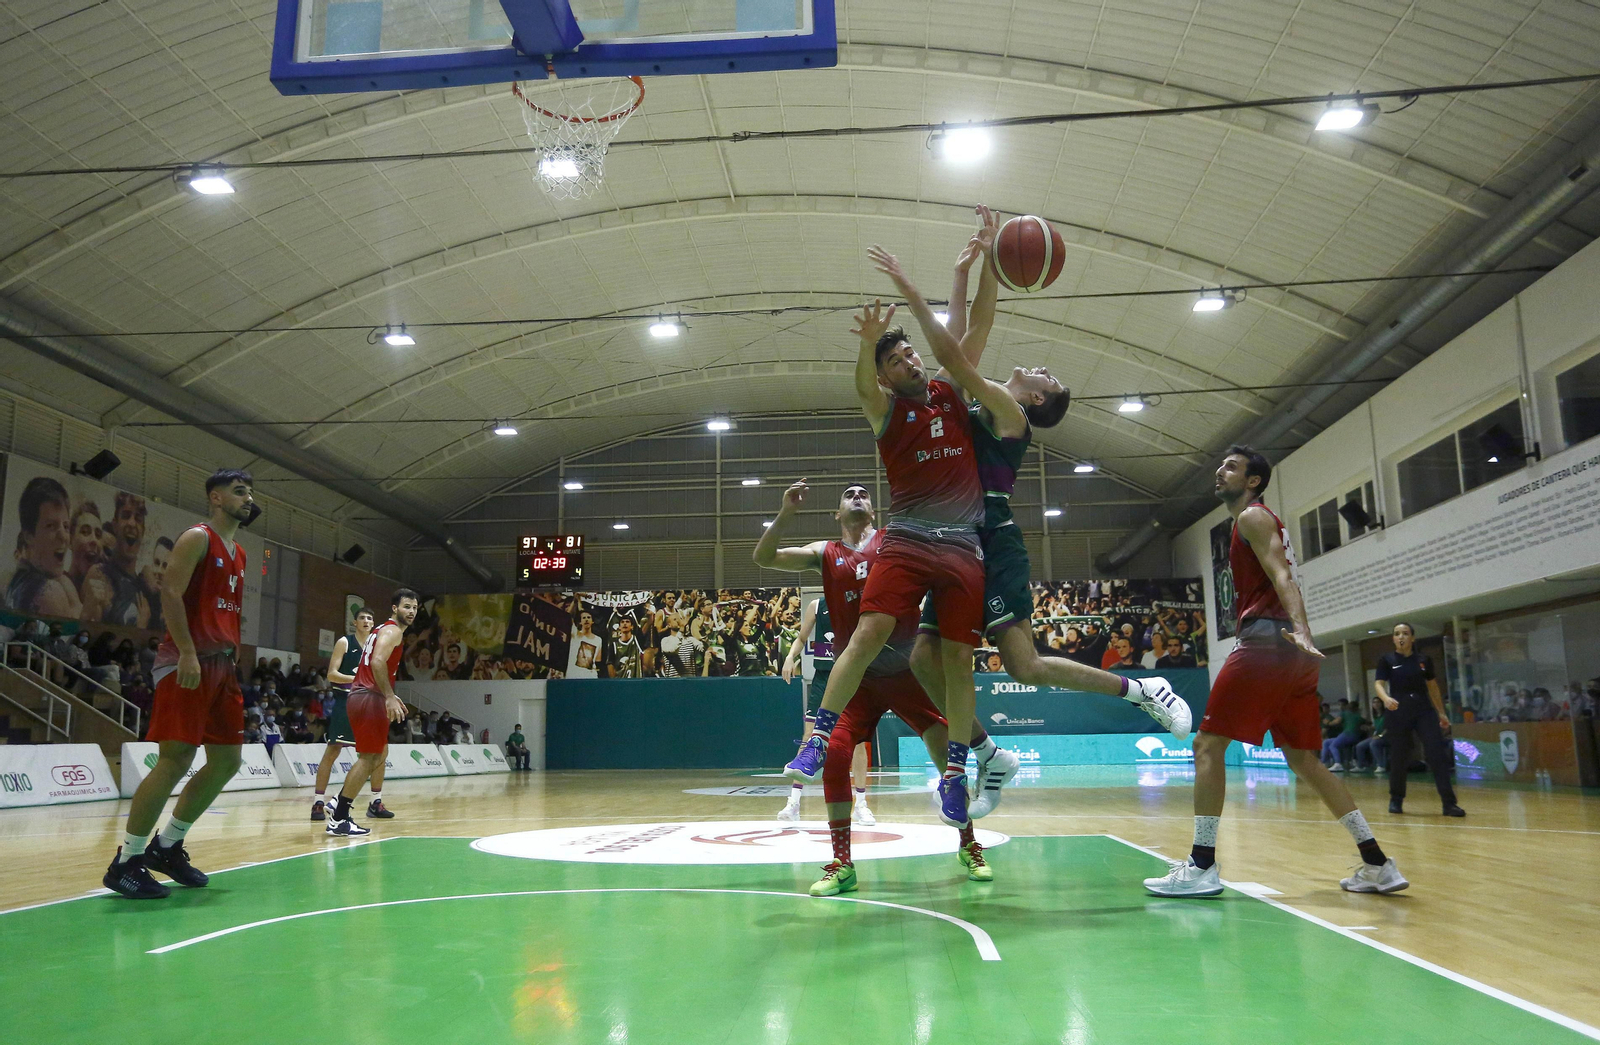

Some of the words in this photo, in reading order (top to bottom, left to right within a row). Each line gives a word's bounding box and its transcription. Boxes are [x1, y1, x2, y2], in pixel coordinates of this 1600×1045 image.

[930, 416, 944, 438] 2
[933, 450, 941, 459] El
[1498, 484, 1530, 505] JUGADORES
[1532, 480, 1540, 491] DE
[1541, 468, 1571, 487] CANTERA
[1572, 461, 1587, 475] QUE
[1588, 455, 1600, 468] HA
[523, 537, 537, 548] 97
[547, 542, 553, 550] 4
[566, 536, 581, 547] 81
[533, 557, 566, 569] 02:39
[523, 568, 529, 577] 5
[575, 567, 581, 576] 4
[855, 561, 867, 580] 8
[229, 574, 238, 593] 4
[1161, 748, 1194, 757] Funda
[248, 766, 272, 777] Unicaja
[98, 786, 112, 794] SUR
